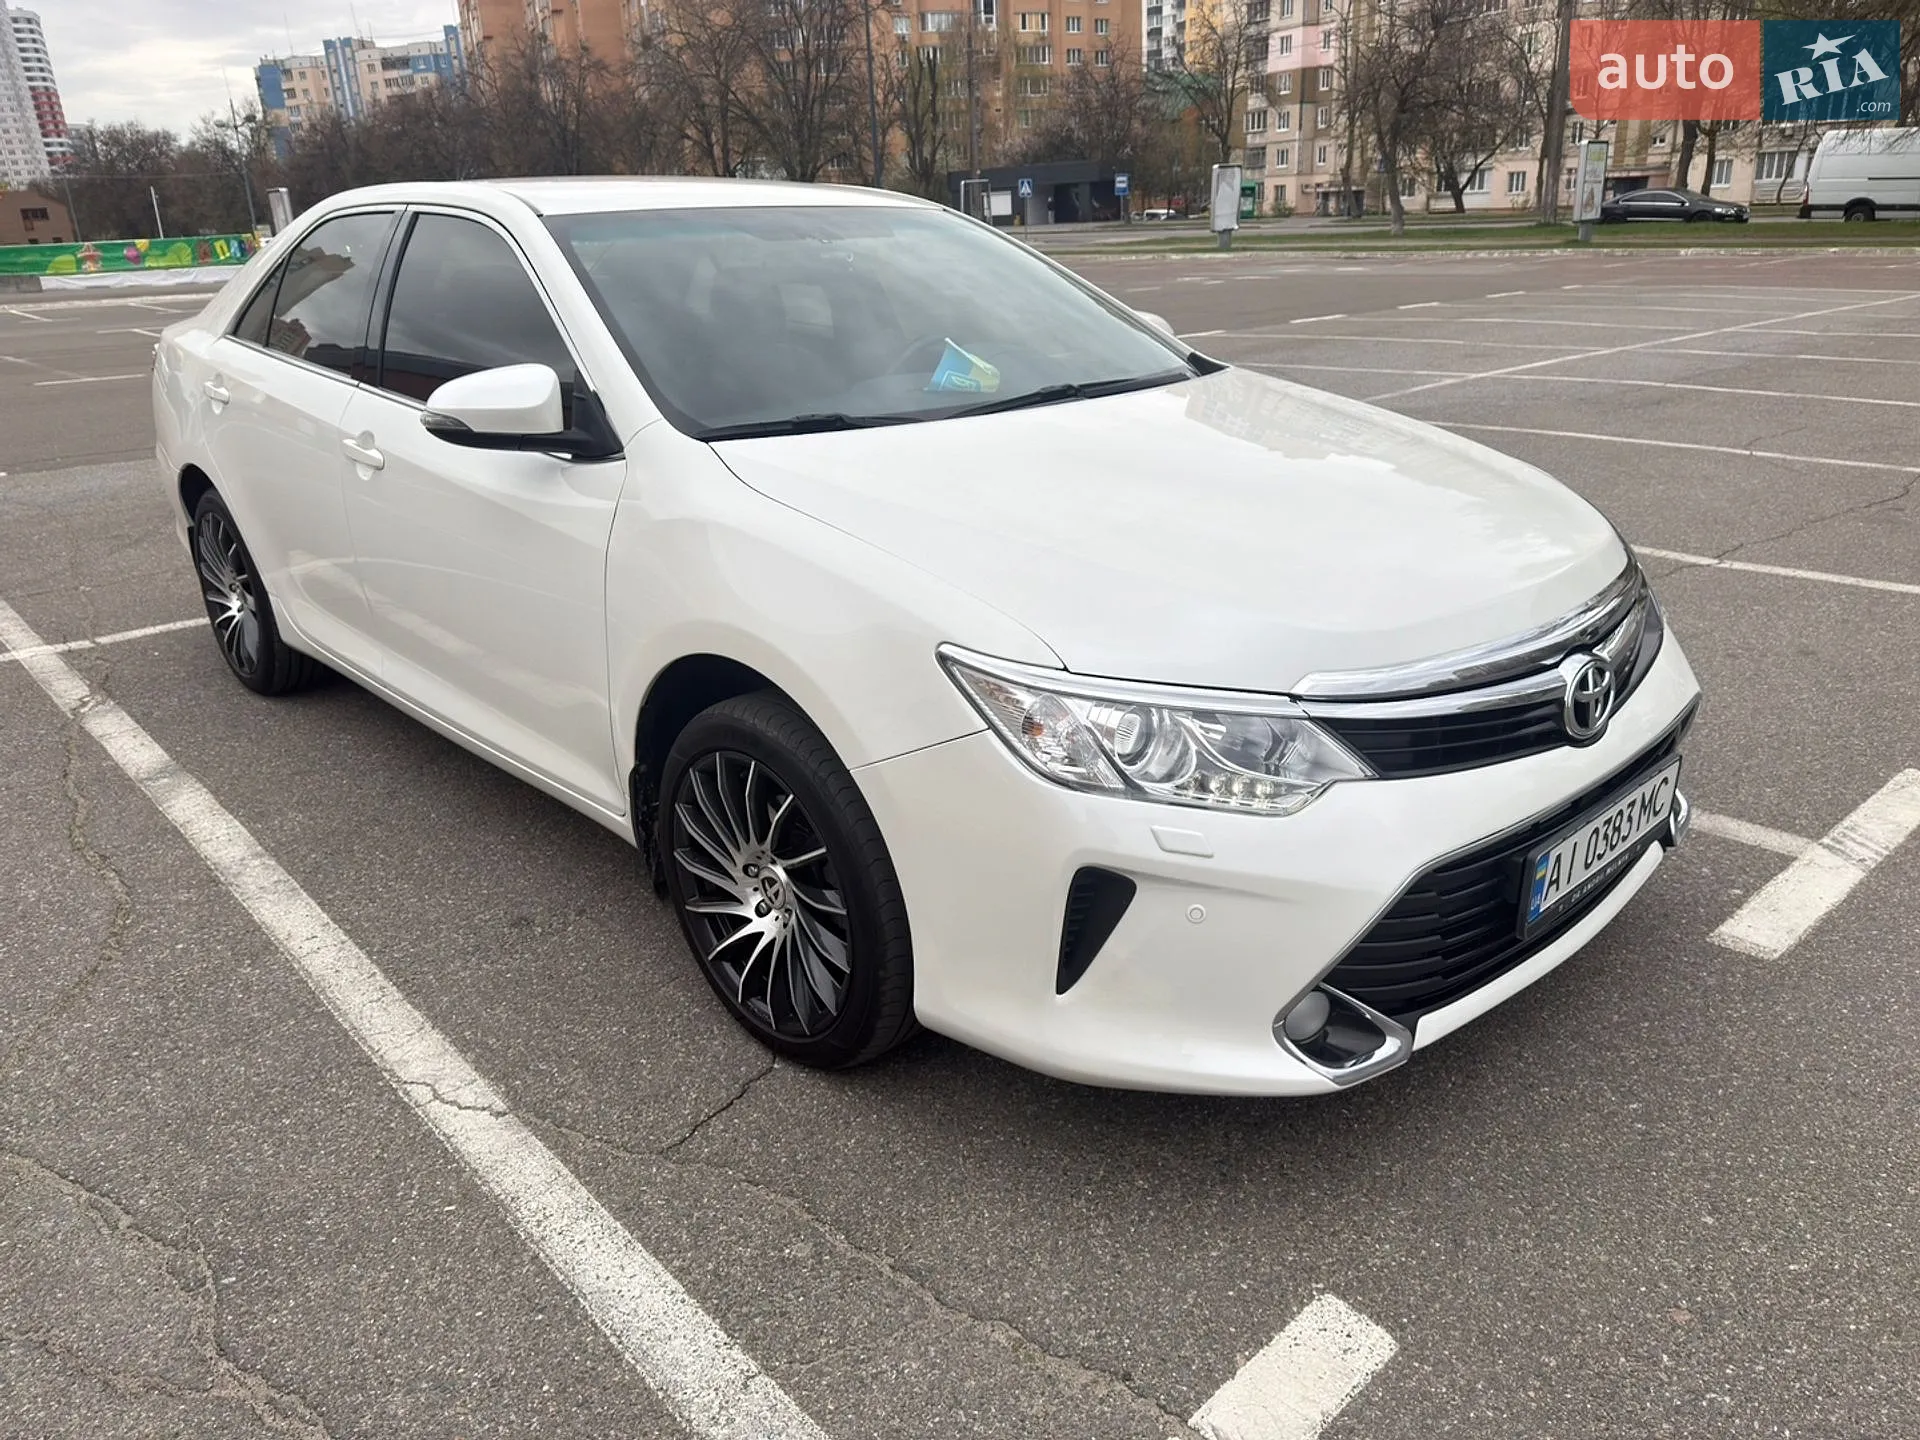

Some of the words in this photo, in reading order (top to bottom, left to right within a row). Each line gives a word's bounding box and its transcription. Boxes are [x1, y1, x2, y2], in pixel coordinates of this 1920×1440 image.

[1543, 841, 1578, 902] AI
[1584, 798, 1637, 871] 0383
[1636, 776, 1669, 832] MC
